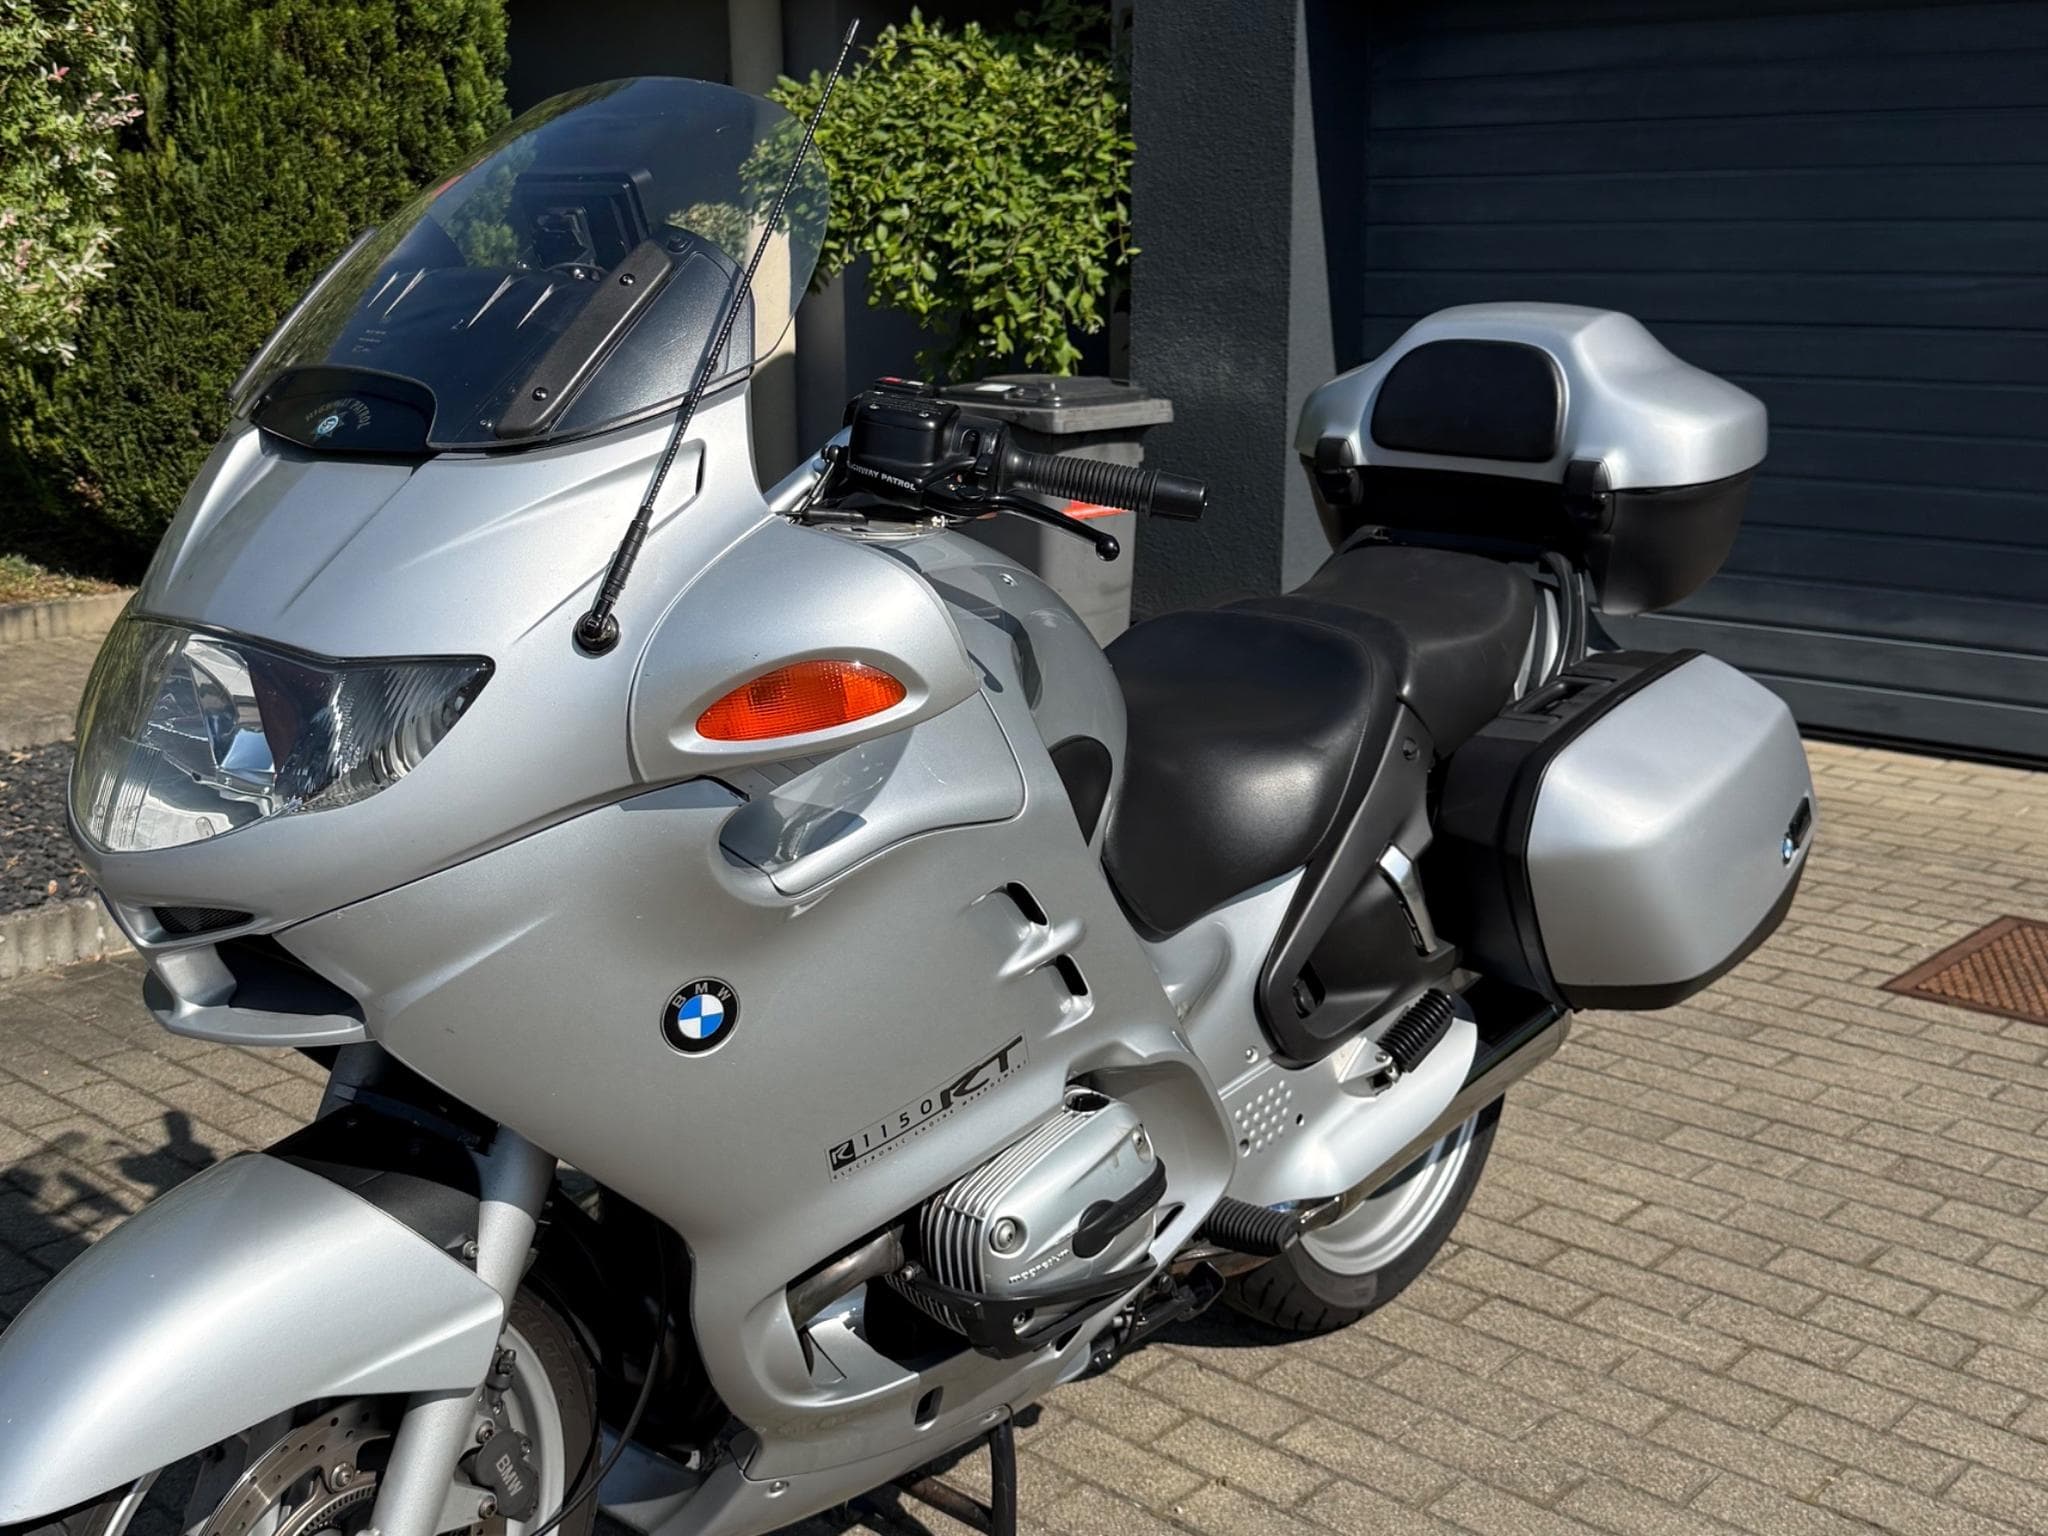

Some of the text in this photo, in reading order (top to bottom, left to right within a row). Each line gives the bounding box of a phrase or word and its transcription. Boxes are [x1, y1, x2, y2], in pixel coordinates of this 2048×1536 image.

[881, 473, 916, 491] PATROL
[672, 982, 732, 1009] BMW
[495, 1453, 524, 1497] BMW
